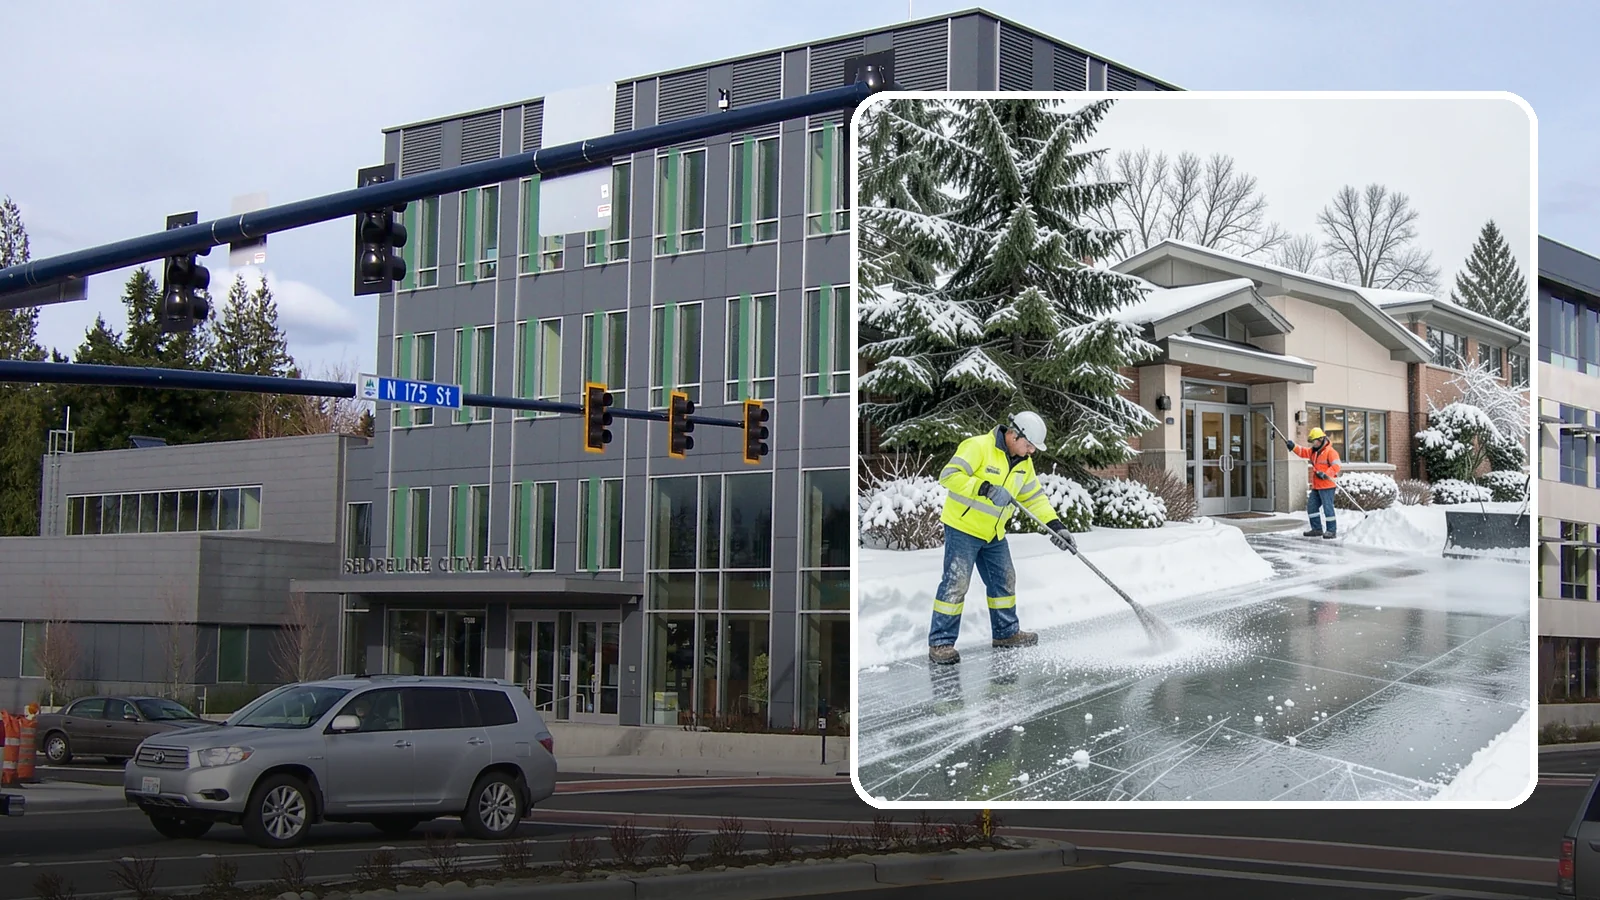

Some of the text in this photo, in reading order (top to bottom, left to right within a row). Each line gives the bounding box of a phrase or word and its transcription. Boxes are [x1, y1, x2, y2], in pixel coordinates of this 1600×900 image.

[387, 380, 451, 406] N 175 St
[344, 556, 525, 574] SHORELINE CITY HALL
